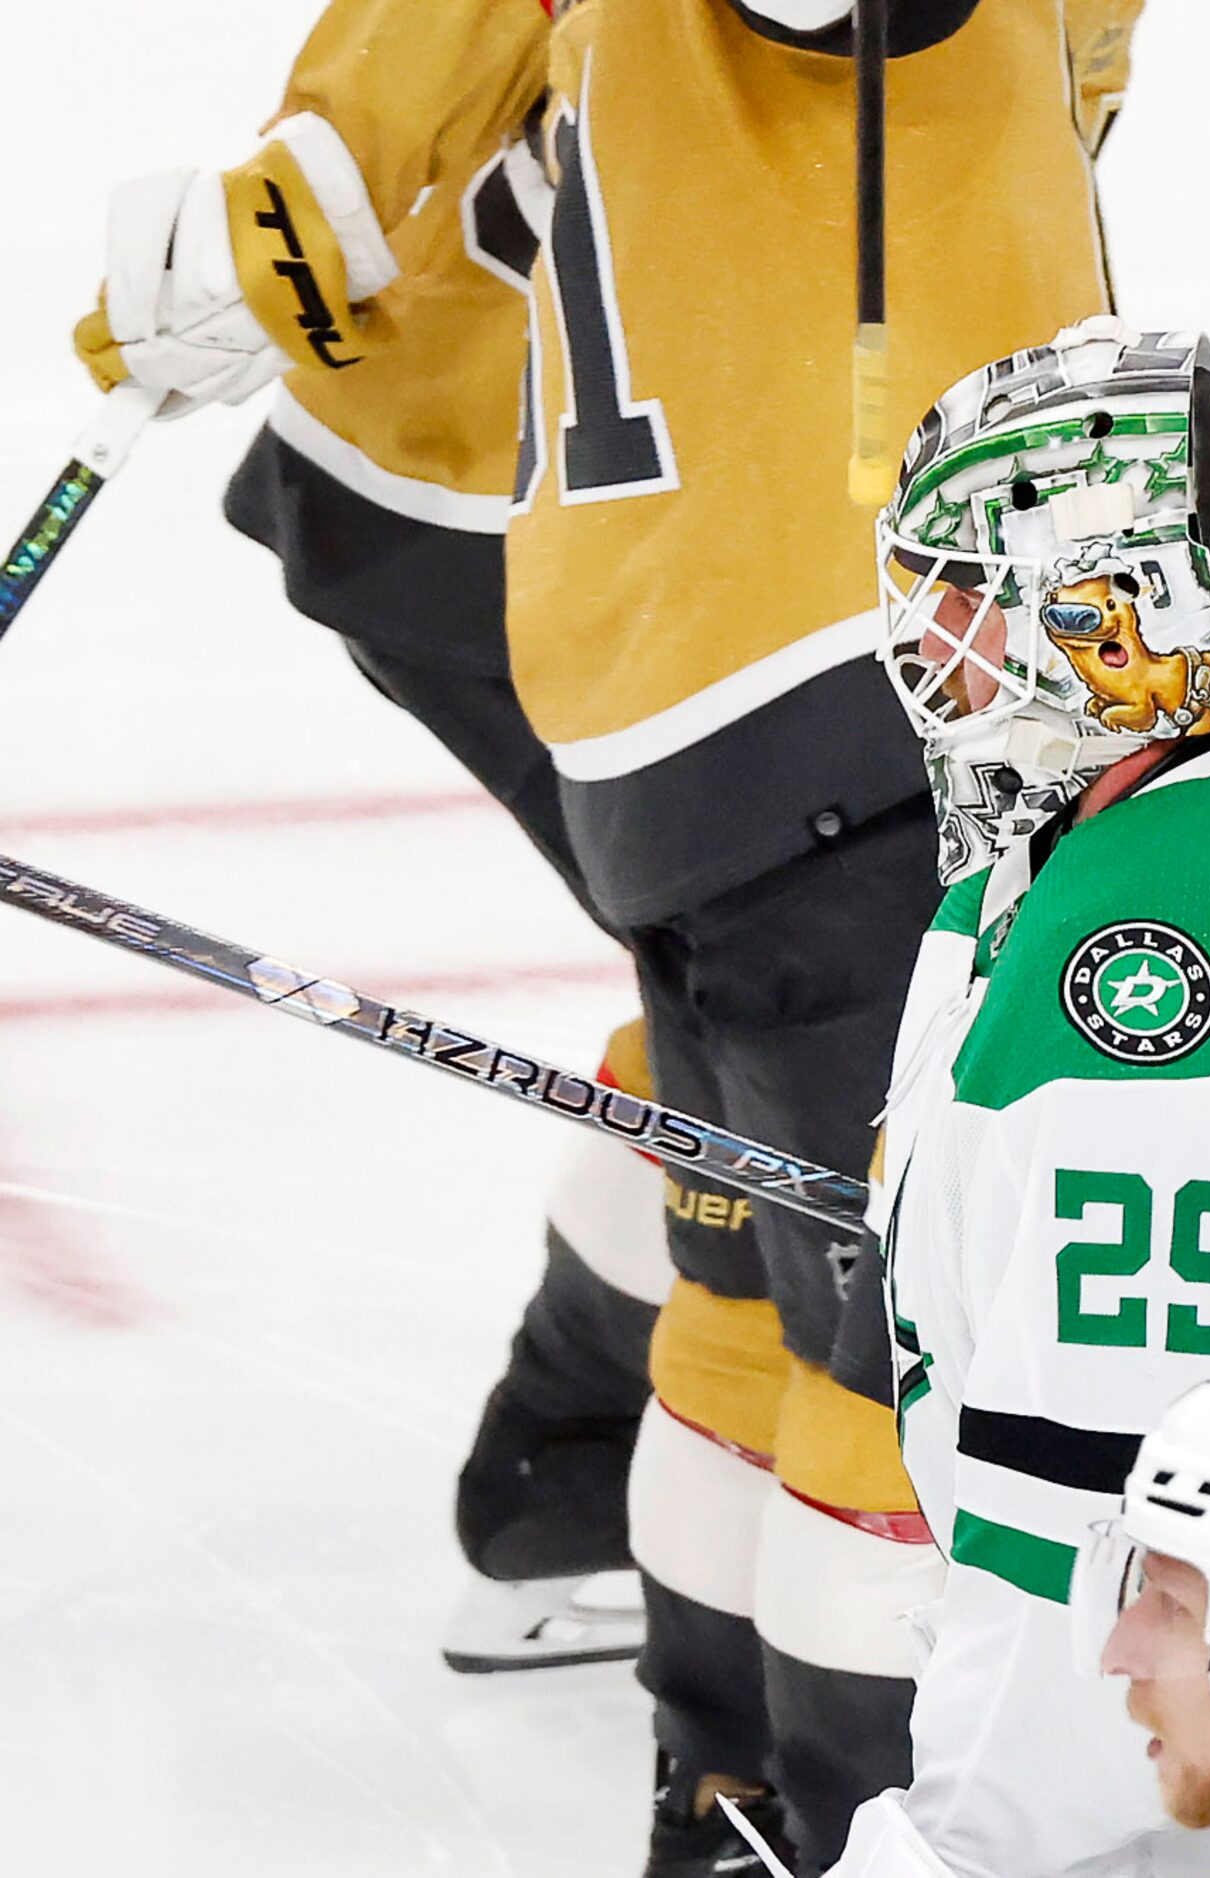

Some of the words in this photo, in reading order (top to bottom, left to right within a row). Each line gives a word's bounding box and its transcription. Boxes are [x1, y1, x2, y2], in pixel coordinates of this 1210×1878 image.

[515, 45, 681, 513] 1
[1074, 932, 1203, 984] DALLAS
[1087, 1013, 1202, 1052] STARS
[667, 1180, 752, 1230] uer
